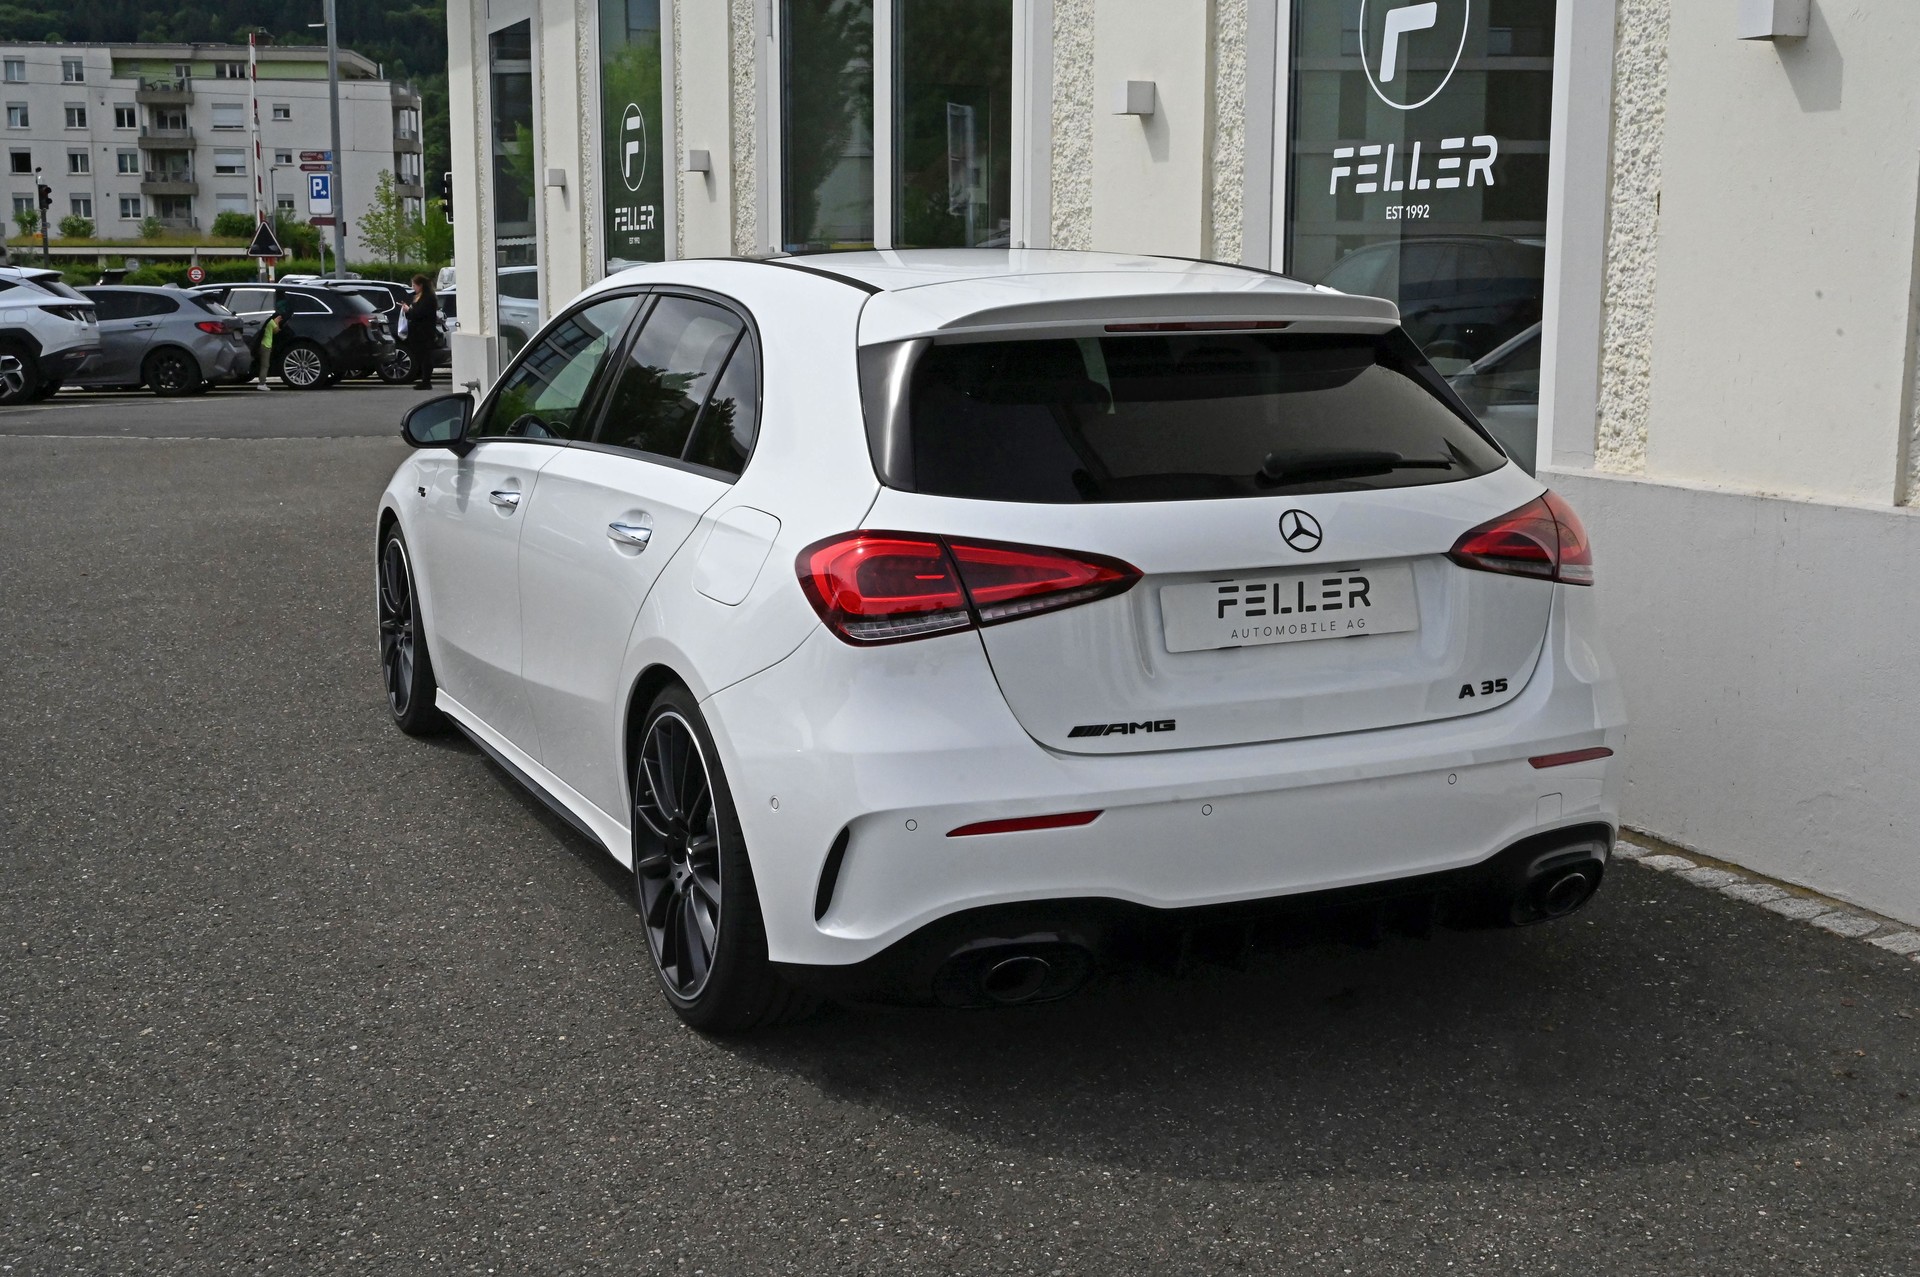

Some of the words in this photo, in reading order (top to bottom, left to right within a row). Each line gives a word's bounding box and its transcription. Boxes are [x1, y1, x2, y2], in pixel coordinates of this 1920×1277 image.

[1329, 134, 1499, 195] FELLER
[312, 178, 323, 197] P
[614, 204, 655, 231] FELLER
[1385, 205, 1404, 220] EST
[1405, 204, 1430, 219] 1992
[1218, 576, 1371, 619] FELLER
[1231, 620, 1337, 639] AUTOMOBILE
[1346, 618, 1366, 630] AG
[1458, 683, 1476, 699] A
[1480, 677, 1508, 695] 35
[1102, 719, 1176, 737] AMG
